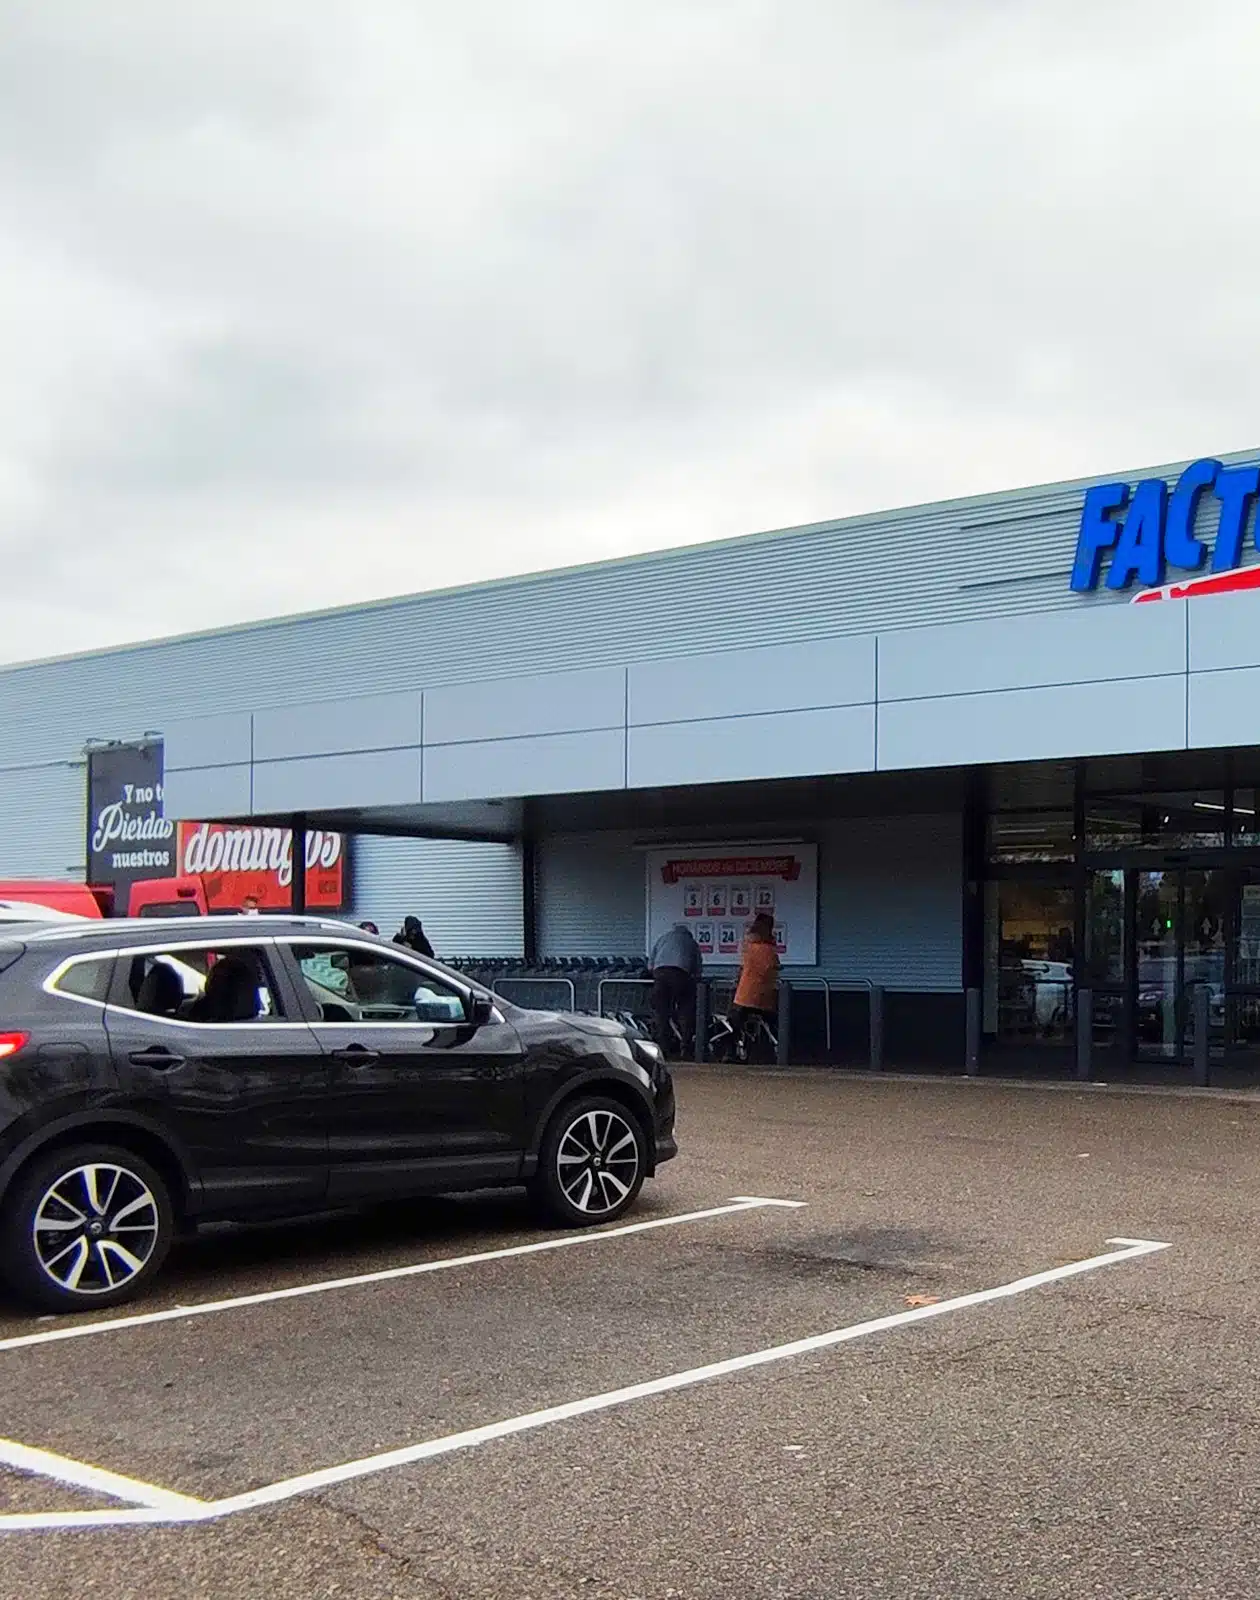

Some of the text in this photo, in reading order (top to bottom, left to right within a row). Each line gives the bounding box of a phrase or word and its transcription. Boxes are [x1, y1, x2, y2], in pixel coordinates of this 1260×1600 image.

[123, 782, 164, 804] Y no t
[92, 800, 174, 853] Pierdas
[112, 849, 170, 869] nuestros
[759, 892, 771, 905] 12
[699, 931, 711, 943] 20
[722, 931, 735, 943] 24
